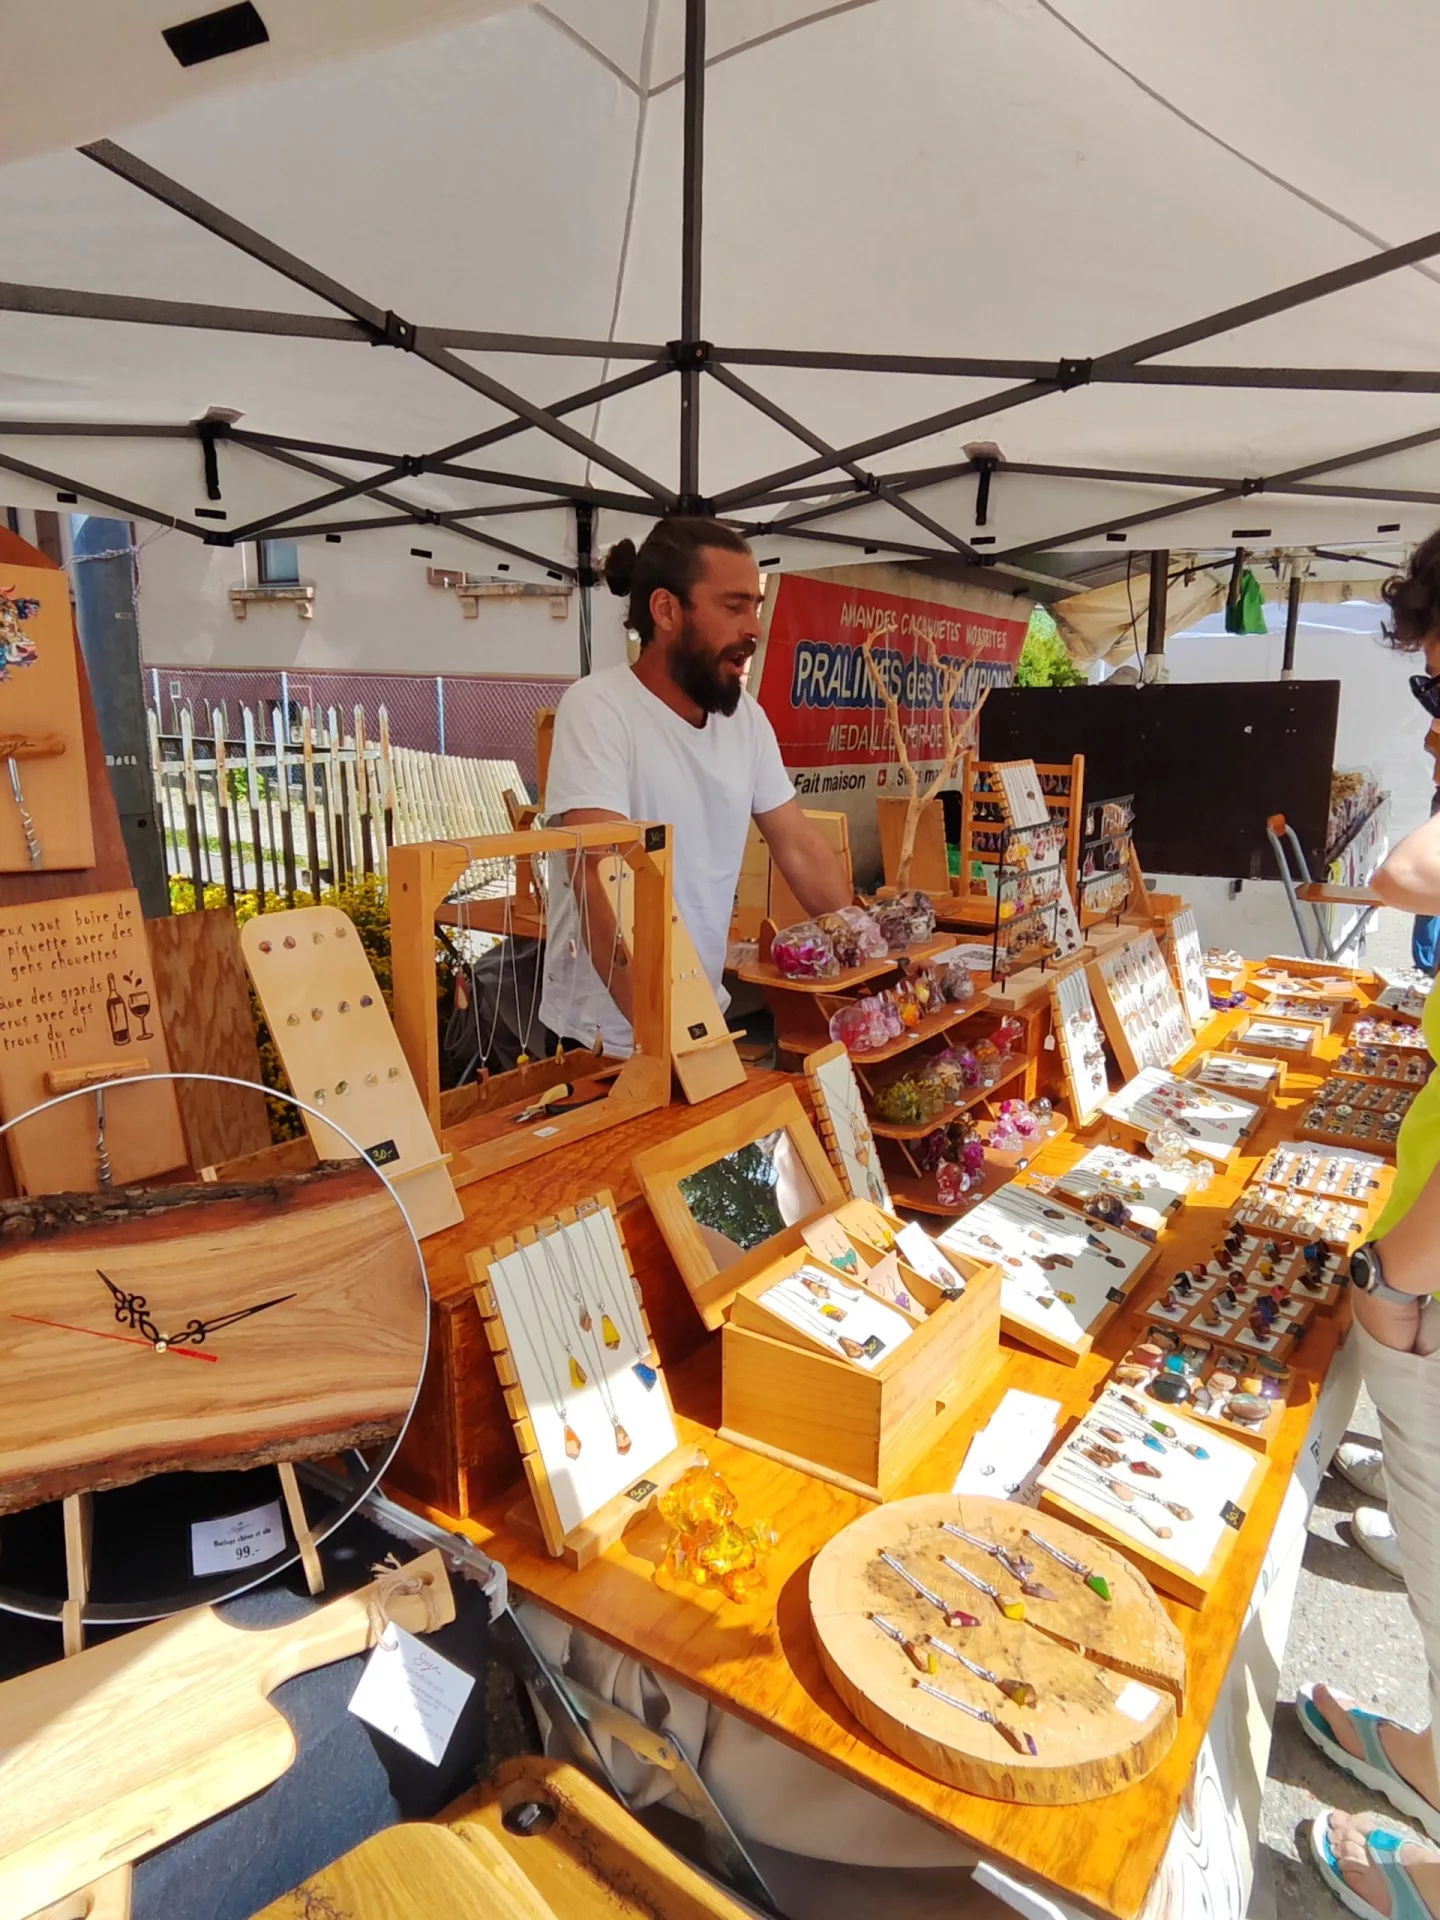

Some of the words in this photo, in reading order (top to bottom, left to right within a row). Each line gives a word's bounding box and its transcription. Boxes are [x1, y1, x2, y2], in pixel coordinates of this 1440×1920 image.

[840, 602, 897, 629] AMANDES
[796, 651, 902, 700] PRALINES
[906, 660, 933, 701] des
[794, 773, 819, 795] Fait
[822, 770, 867, 793] maison
[31, 917, 60, 933] vaut
[75, 910, 109, 927] boire
[117, 903, 132, 920] de
[8, 937, 67, 962] piquette
[75, 931, 104, 947] avec
[111, 923, 134, 940] des
[11, 961, 43, 982] gens
[51, 948, 119, 971] chouettes
[31, 986, 53, 1005] des
[61, 977, 103, 1004] grands
[0, 1015, 28, 1031] crus
[36, 1010, 64, 1024] avec
[72, 1000, 93, 1016] des
[3, 1033, 40, 1052] trous
[47, 1024, 62, 1041] du
[69, 1017, 87, 1037] cul
[235, 1545, 260, 1561] 99.-
